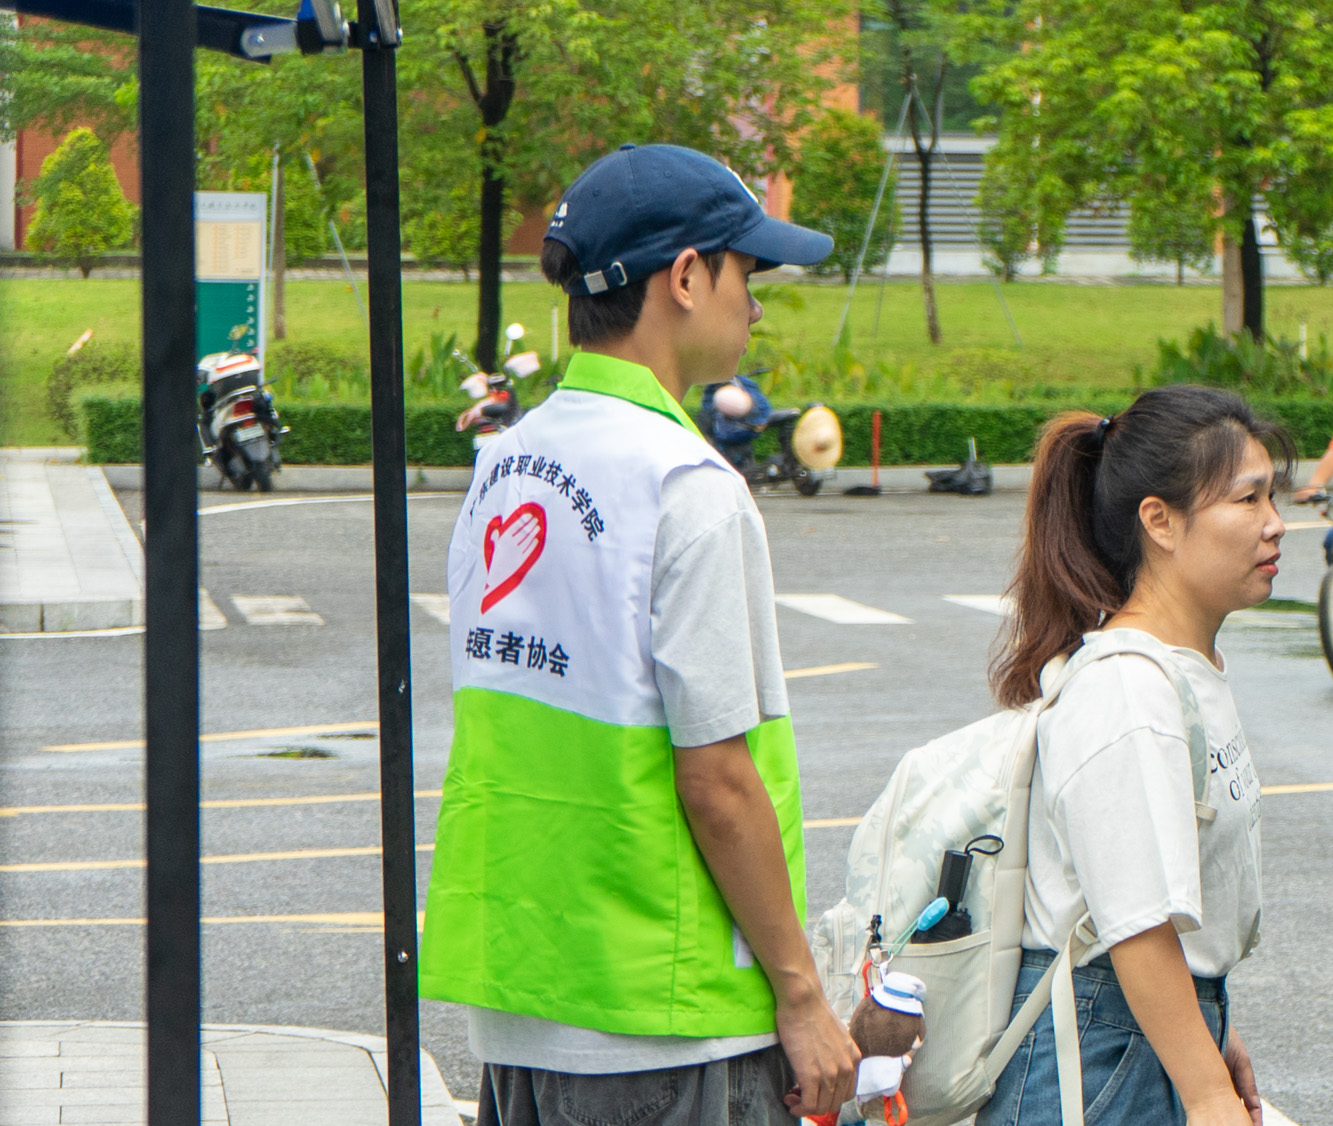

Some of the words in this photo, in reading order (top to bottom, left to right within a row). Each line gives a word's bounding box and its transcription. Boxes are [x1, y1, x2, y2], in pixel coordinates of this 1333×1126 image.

[470, 454, 606, 542] 东建设职业技术学院
